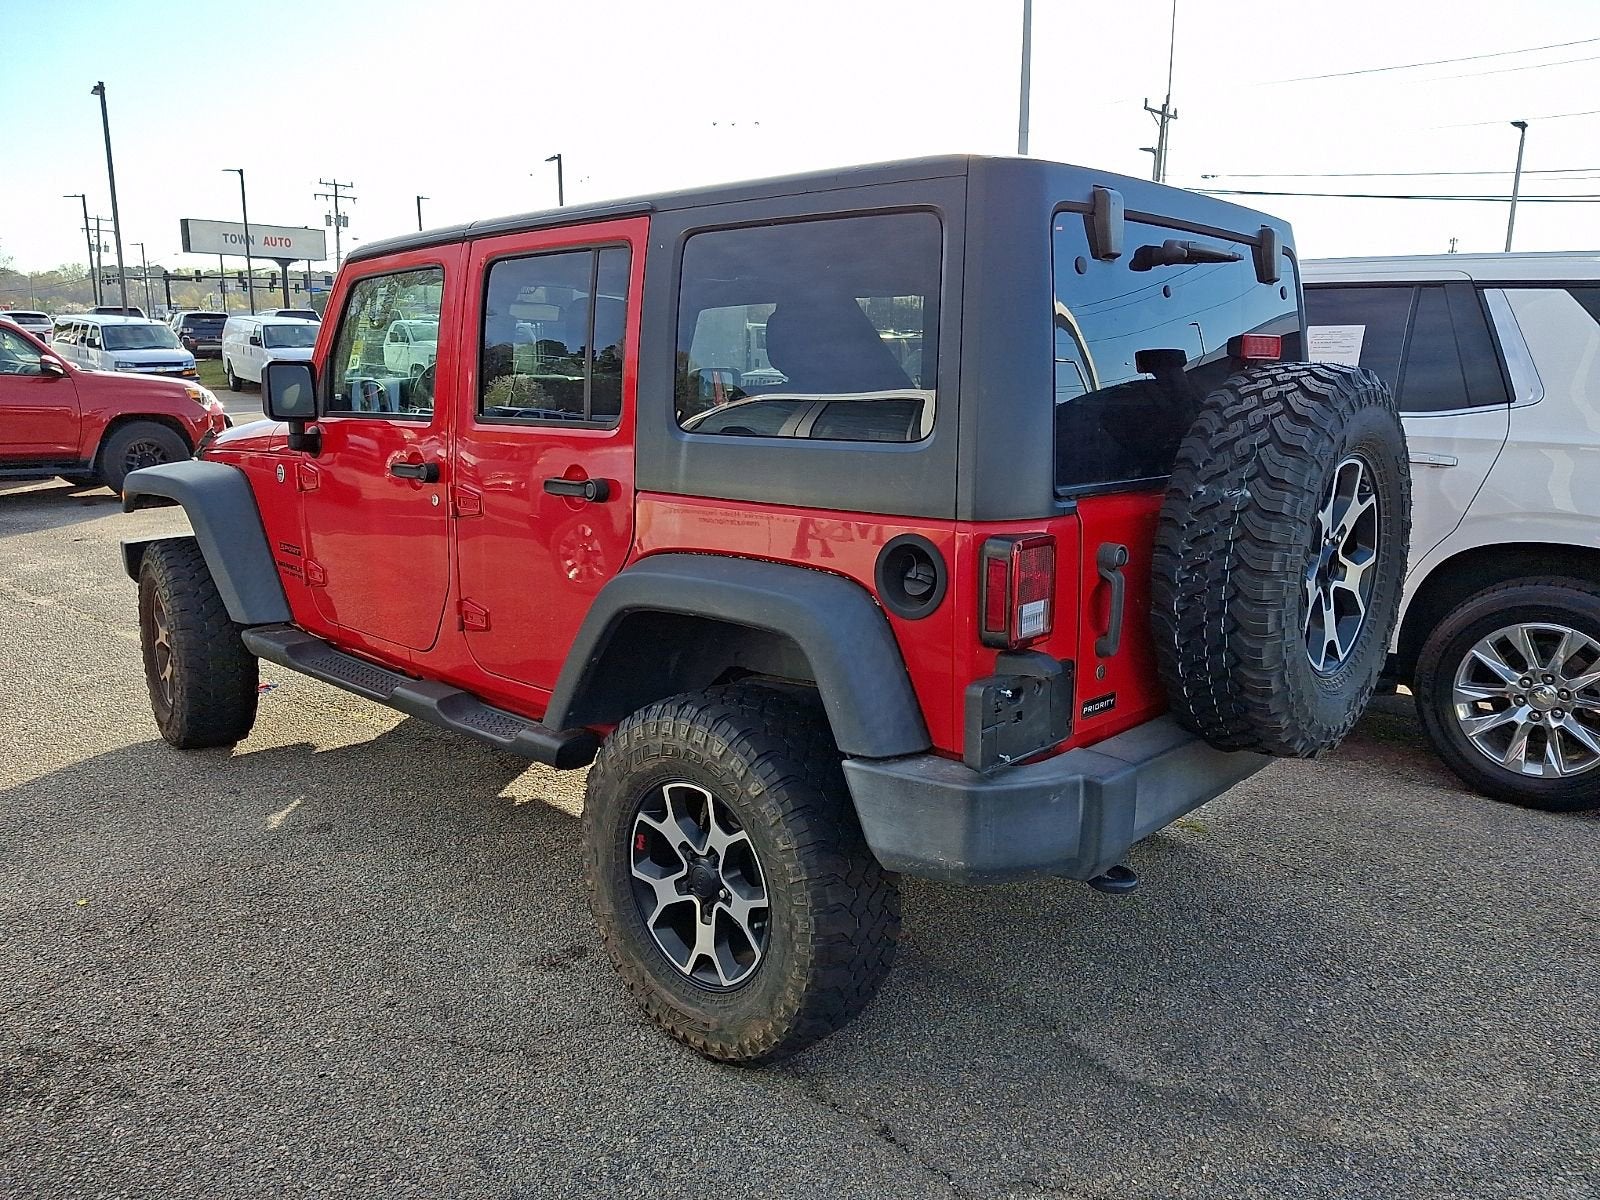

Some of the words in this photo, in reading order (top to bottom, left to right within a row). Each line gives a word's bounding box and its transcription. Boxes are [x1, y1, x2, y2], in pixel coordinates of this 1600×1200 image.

[222, 233, 255, 246] TOWN
[263, 236, 292, 248] AUTO
[1083, 697, 1115, 714] PRIORITY
